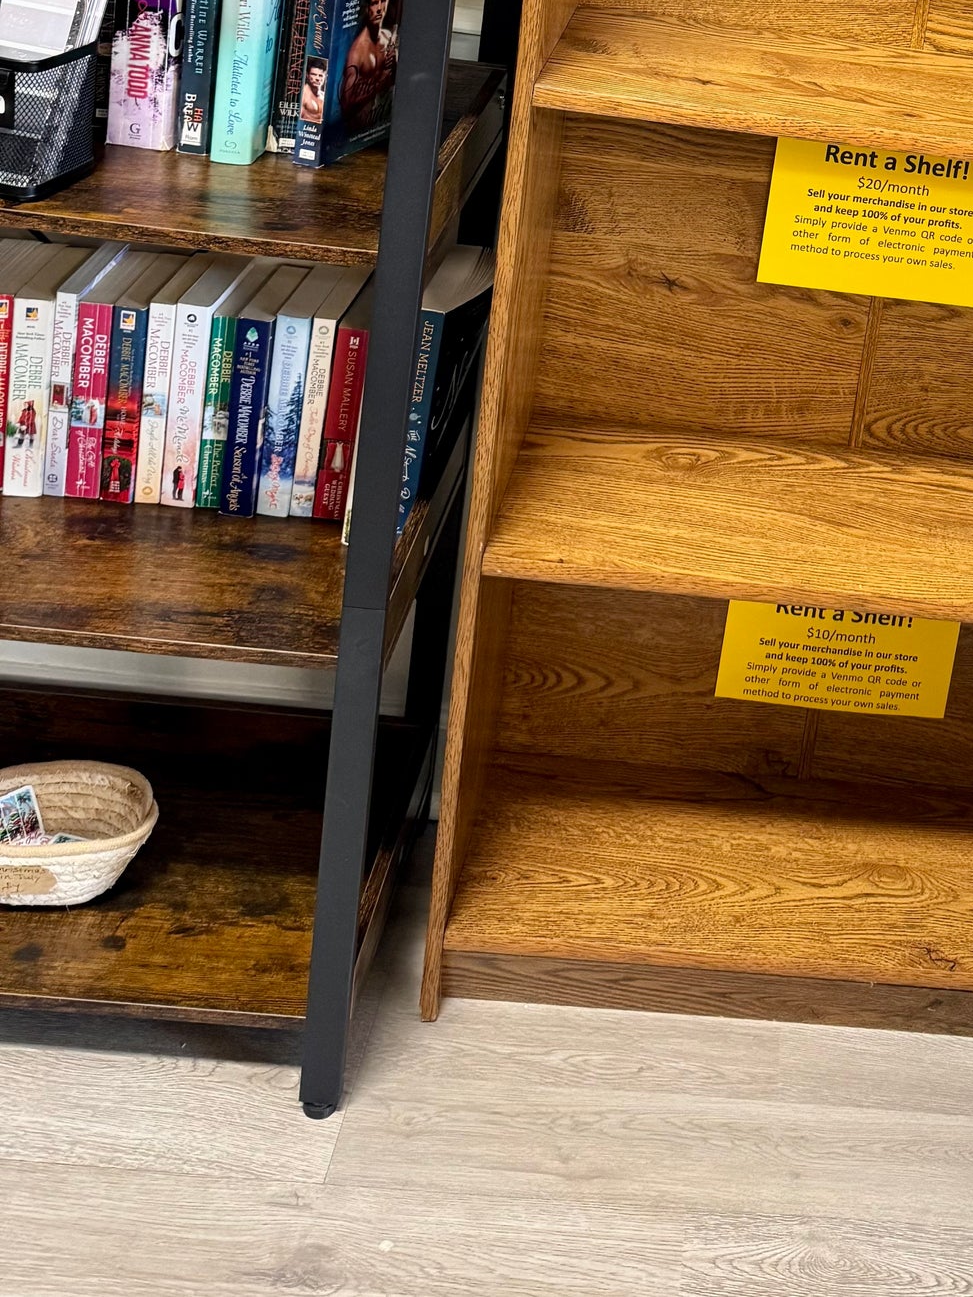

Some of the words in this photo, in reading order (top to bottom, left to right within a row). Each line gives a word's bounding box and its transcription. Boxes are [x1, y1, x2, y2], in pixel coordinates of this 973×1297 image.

[127, 23, 152, 66] ANNA
[127, 64, 149, 100] TODD
[824, 143, 879, 168] Rent
[883, 150, 900, 171] a
[902, 154, 970, 180] Shelf!
[856, 174, 930, 197] $20/month
[77, 317, 95, 389] MACOMBER
[420, 320, 435, 352] JEAN
[93, 334, 108, 375] DEBBIE
[344, 349, 357, 385] SUSAN
[411, 352, 429, 403] MELTZER
[338, 387, 353, 432] MALLERY
[832, 610, 844, 622] a
[805, 625, 876, 645] $10/month
